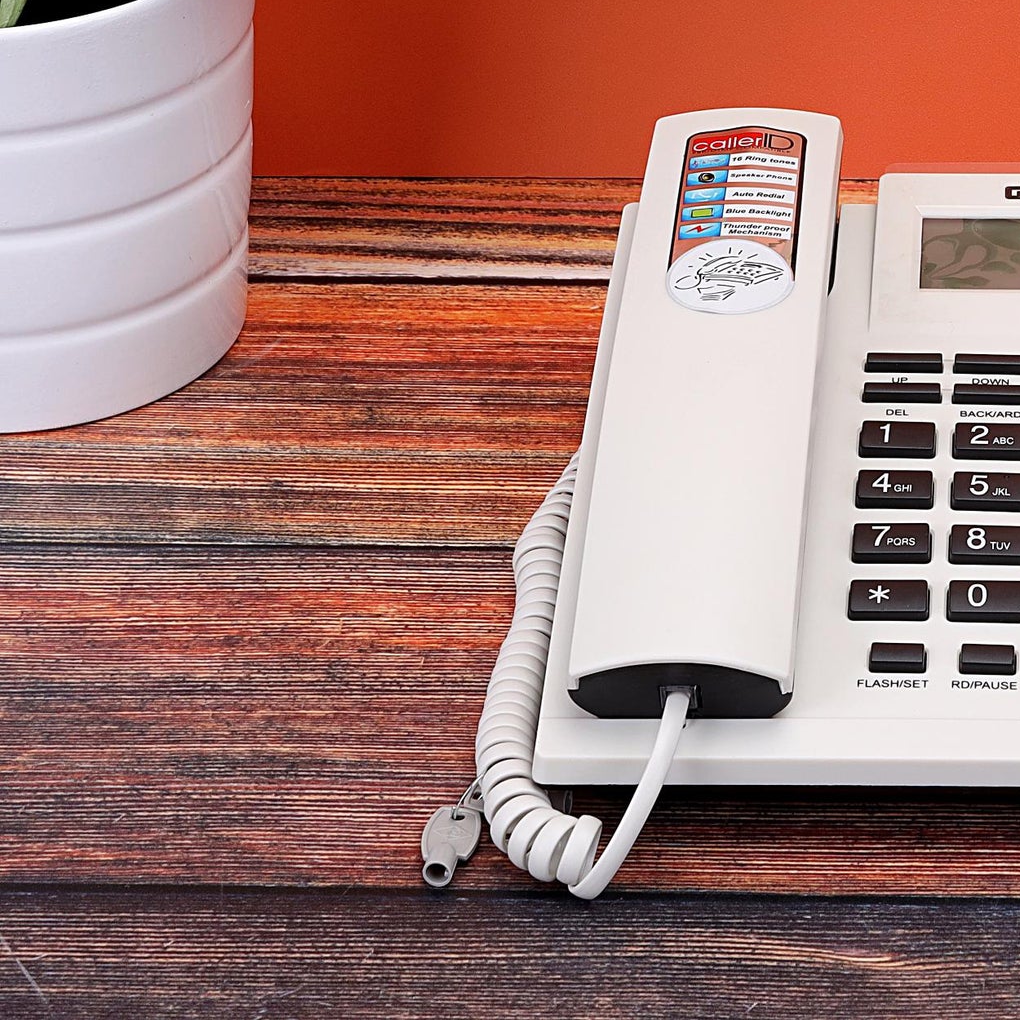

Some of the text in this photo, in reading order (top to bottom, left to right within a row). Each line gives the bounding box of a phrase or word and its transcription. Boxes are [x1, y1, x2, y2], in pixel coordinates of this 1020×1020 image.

[744, 155, 767, 163] Ring
[770, 158, 796, 166] tones
[748, 209, 792, 218] Backlight
[728, 229, 782, 237] Mechanism
[972, 377, 1010, 386] DOWN
[885, 409, 909, 417] DEL
[879, 423, 890, 443] 1
[970, 425, 1014, 445] 2 ABC
[872, 473, 912, 493] 4 GHI
[969, 475, 1011, 496] 5 JKL
[871, 526, 916, 547] 7 PQRS
[966, 528, 1011, 551] 8 TUV
[967, 584, 988, 607] 0
[857, 679, 929, 689] FLASH/SET
[951, 680, 1018, 690] RD/PAUSE
